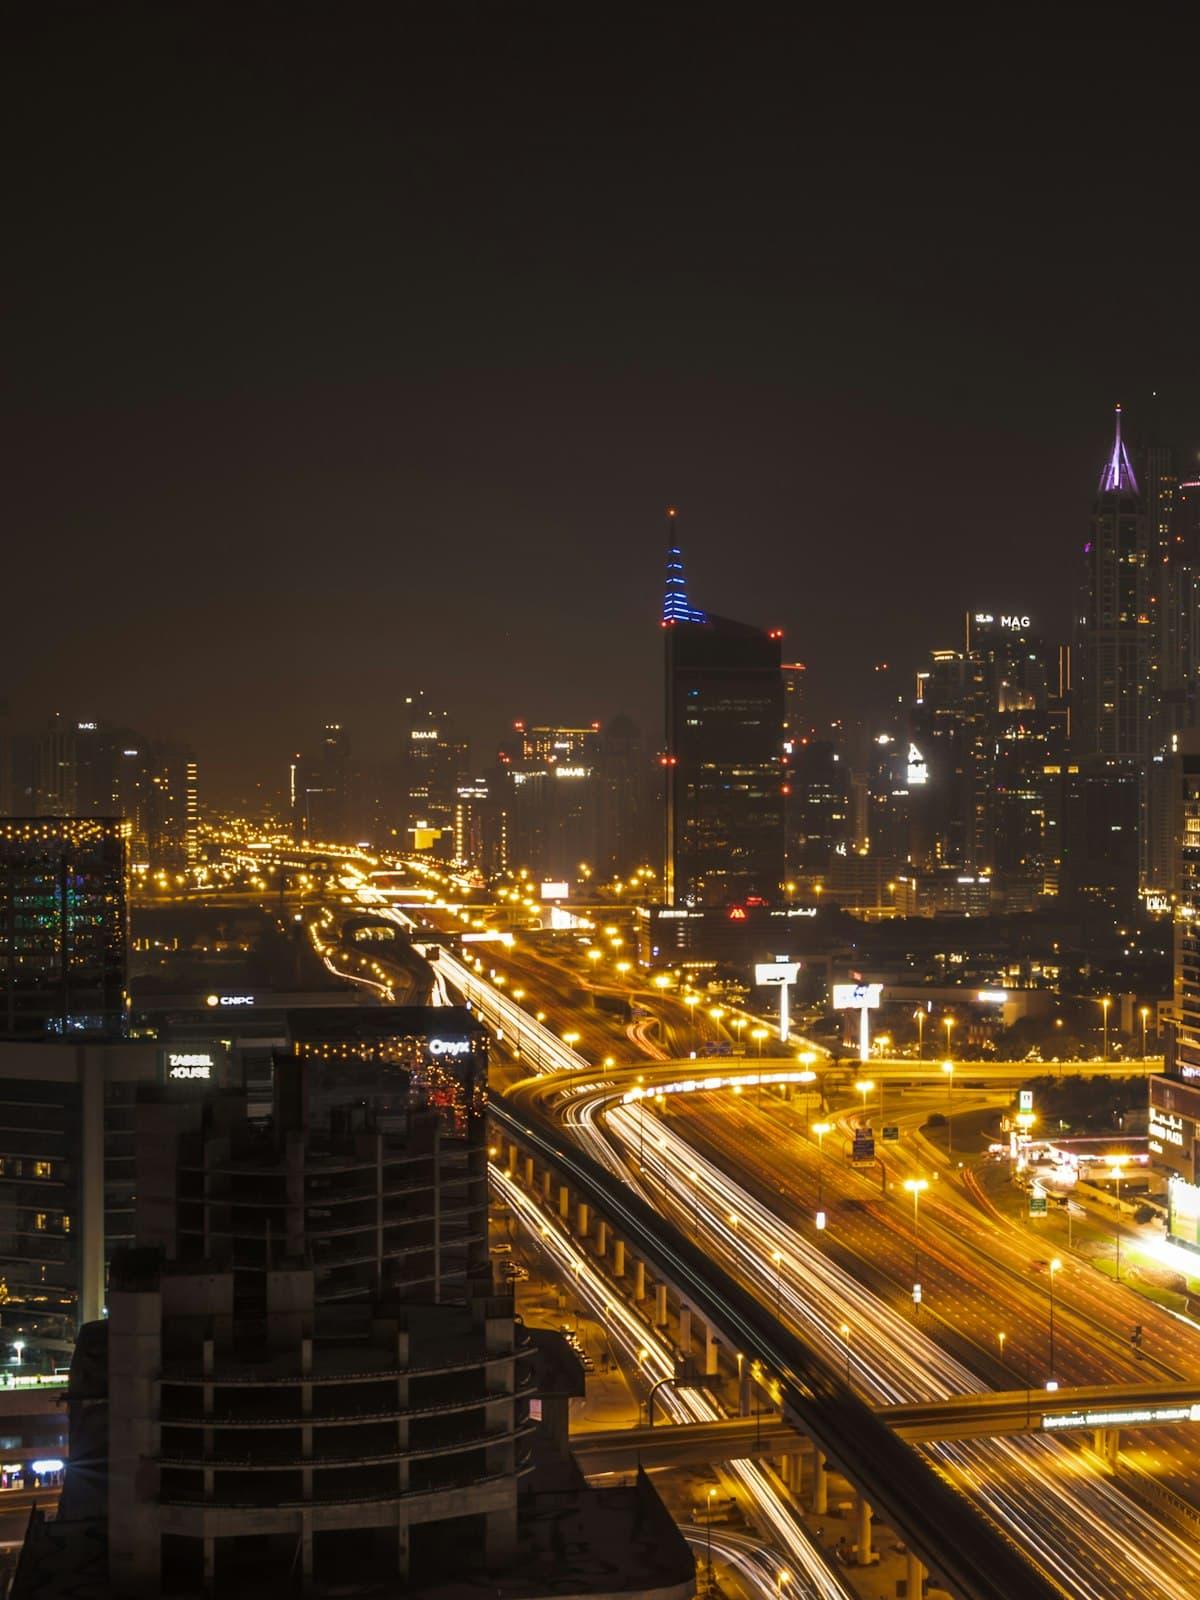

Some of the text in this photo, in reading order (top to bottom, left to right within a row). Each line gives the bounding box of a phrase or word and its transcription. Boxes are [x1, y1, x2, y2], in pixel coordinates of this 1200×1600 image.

[1000, 615, 1031, 628] MAG
[555, 767, 585, 777] EMAAR
[220, 996, 255, 1005] CNPC
[429, 1039, 470, 1056] Onyx
[169, 1066, 211, 1079] HOUSE
[1166, 1128, 1183, 1146] PLAZA
